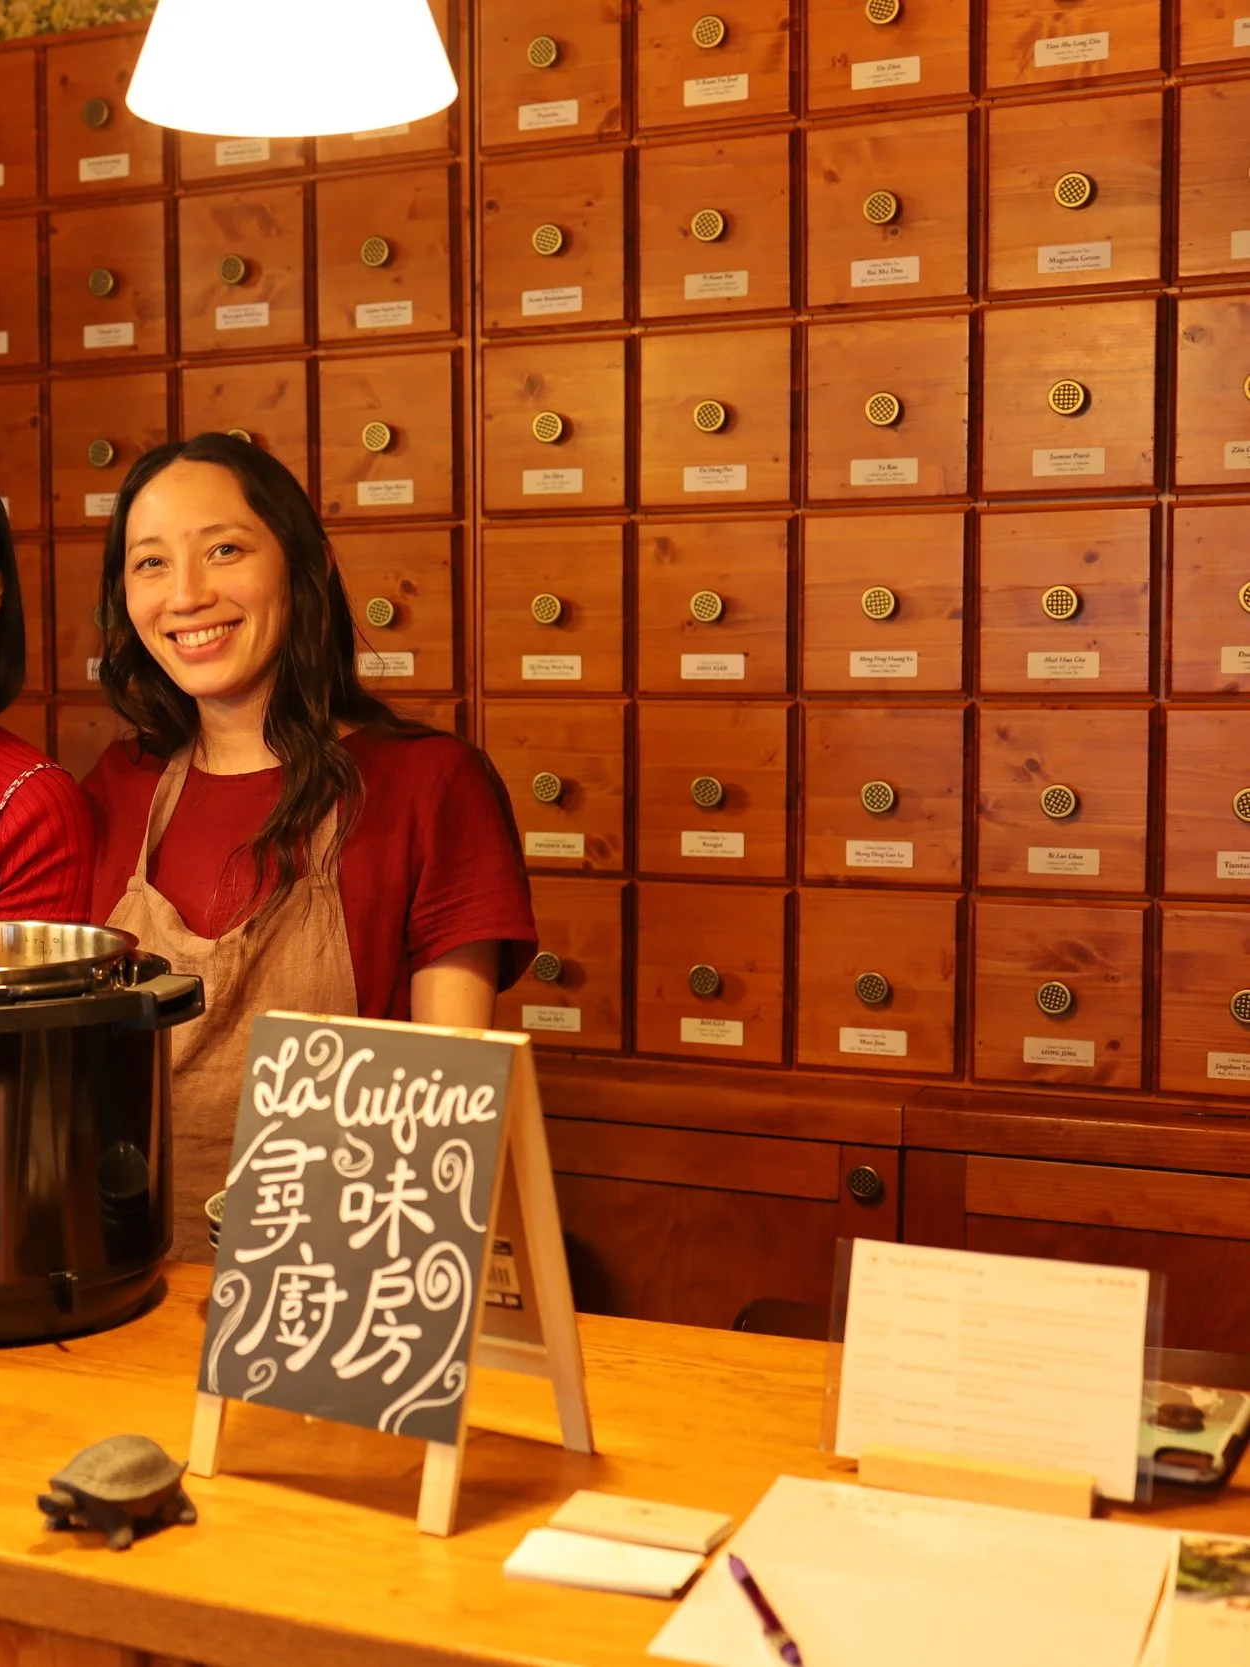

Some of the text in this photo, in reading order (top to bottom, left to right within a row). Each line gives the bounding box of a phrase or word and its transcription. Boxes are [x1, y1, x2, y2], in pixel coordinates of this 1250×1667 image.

[252, 1035, 497, 1154] La Cuisine
[234, 1138, 436, 1264] 尋味
[234, 1242, 424, 1386] 廚房
